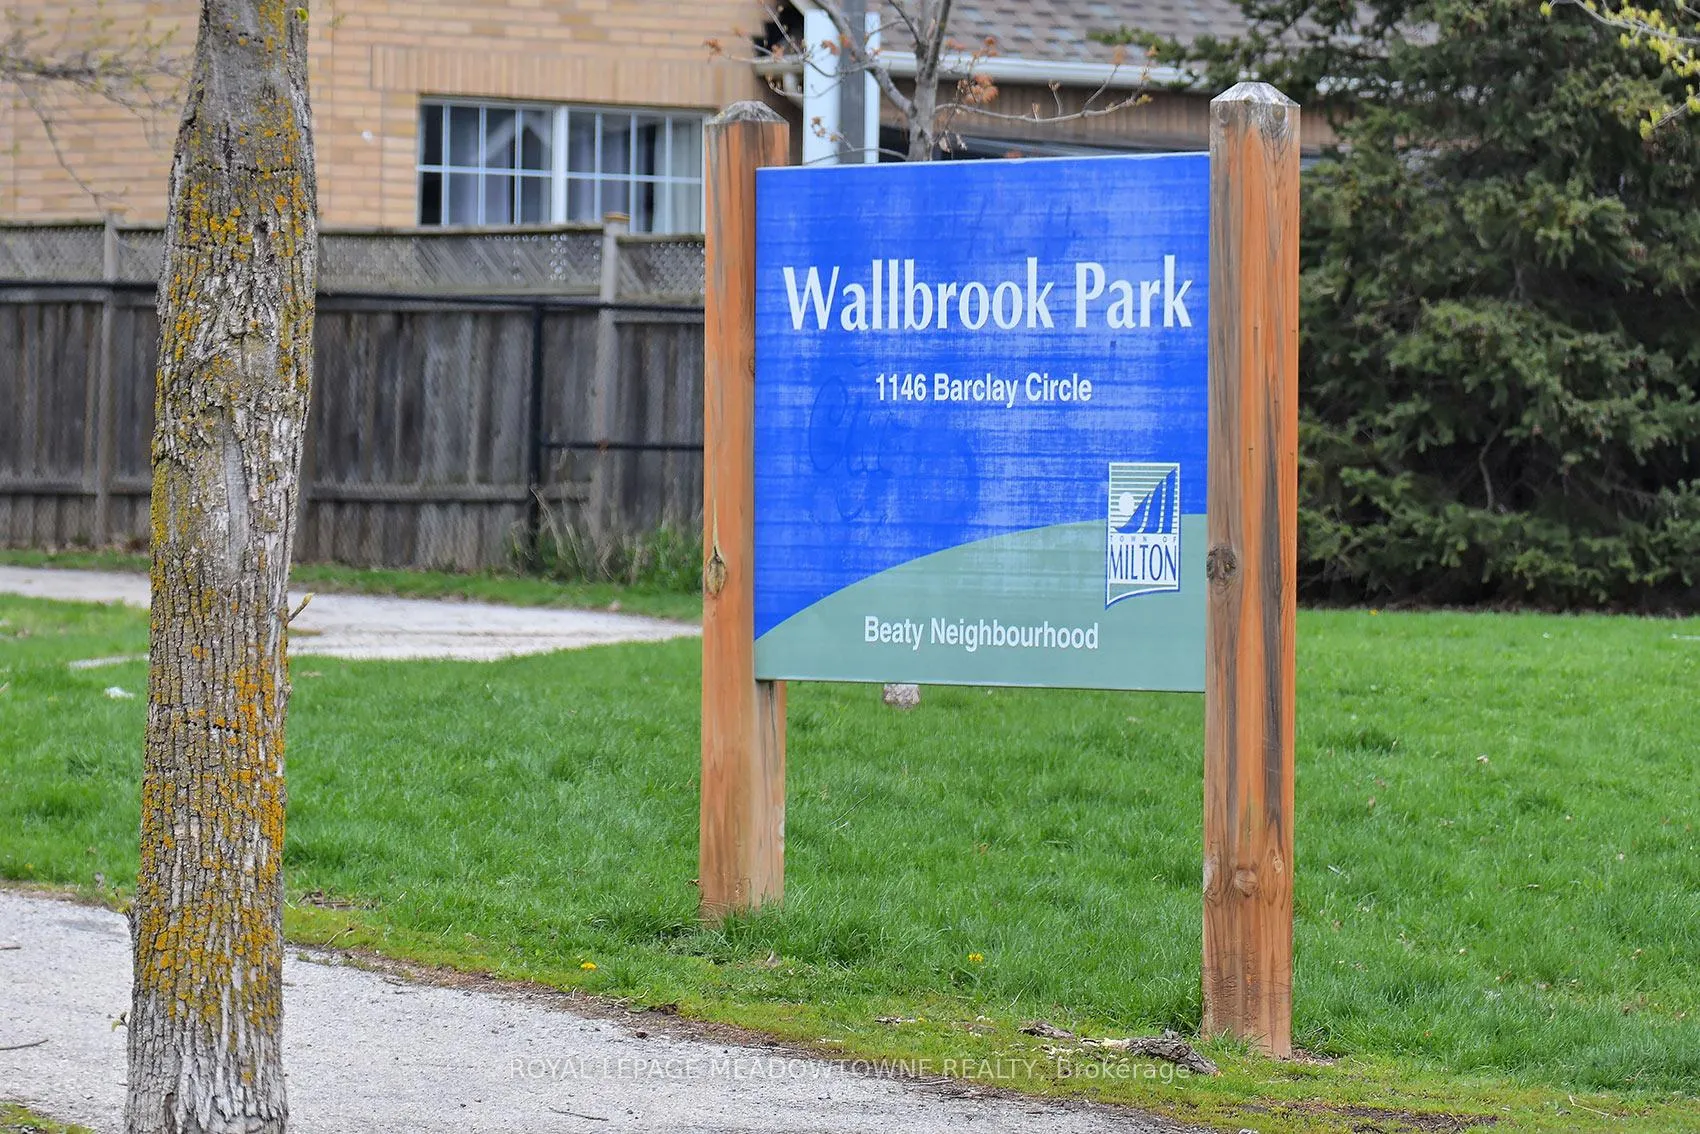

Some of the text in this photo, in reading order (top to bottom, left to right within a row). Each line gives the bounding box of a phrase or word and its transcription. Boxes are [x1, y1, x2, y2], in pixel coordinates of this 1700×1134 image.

[782, 254, 1193, 331] Wallbrook Park
[875, 372, 1092, 408] 1146 Barclay Circle
[1109, 535, 1177, 543] TOWN OF
[1109, 543, 1177, 581] MILTON
[864, 615, 1099, 652] Beaty Neighbourhood
